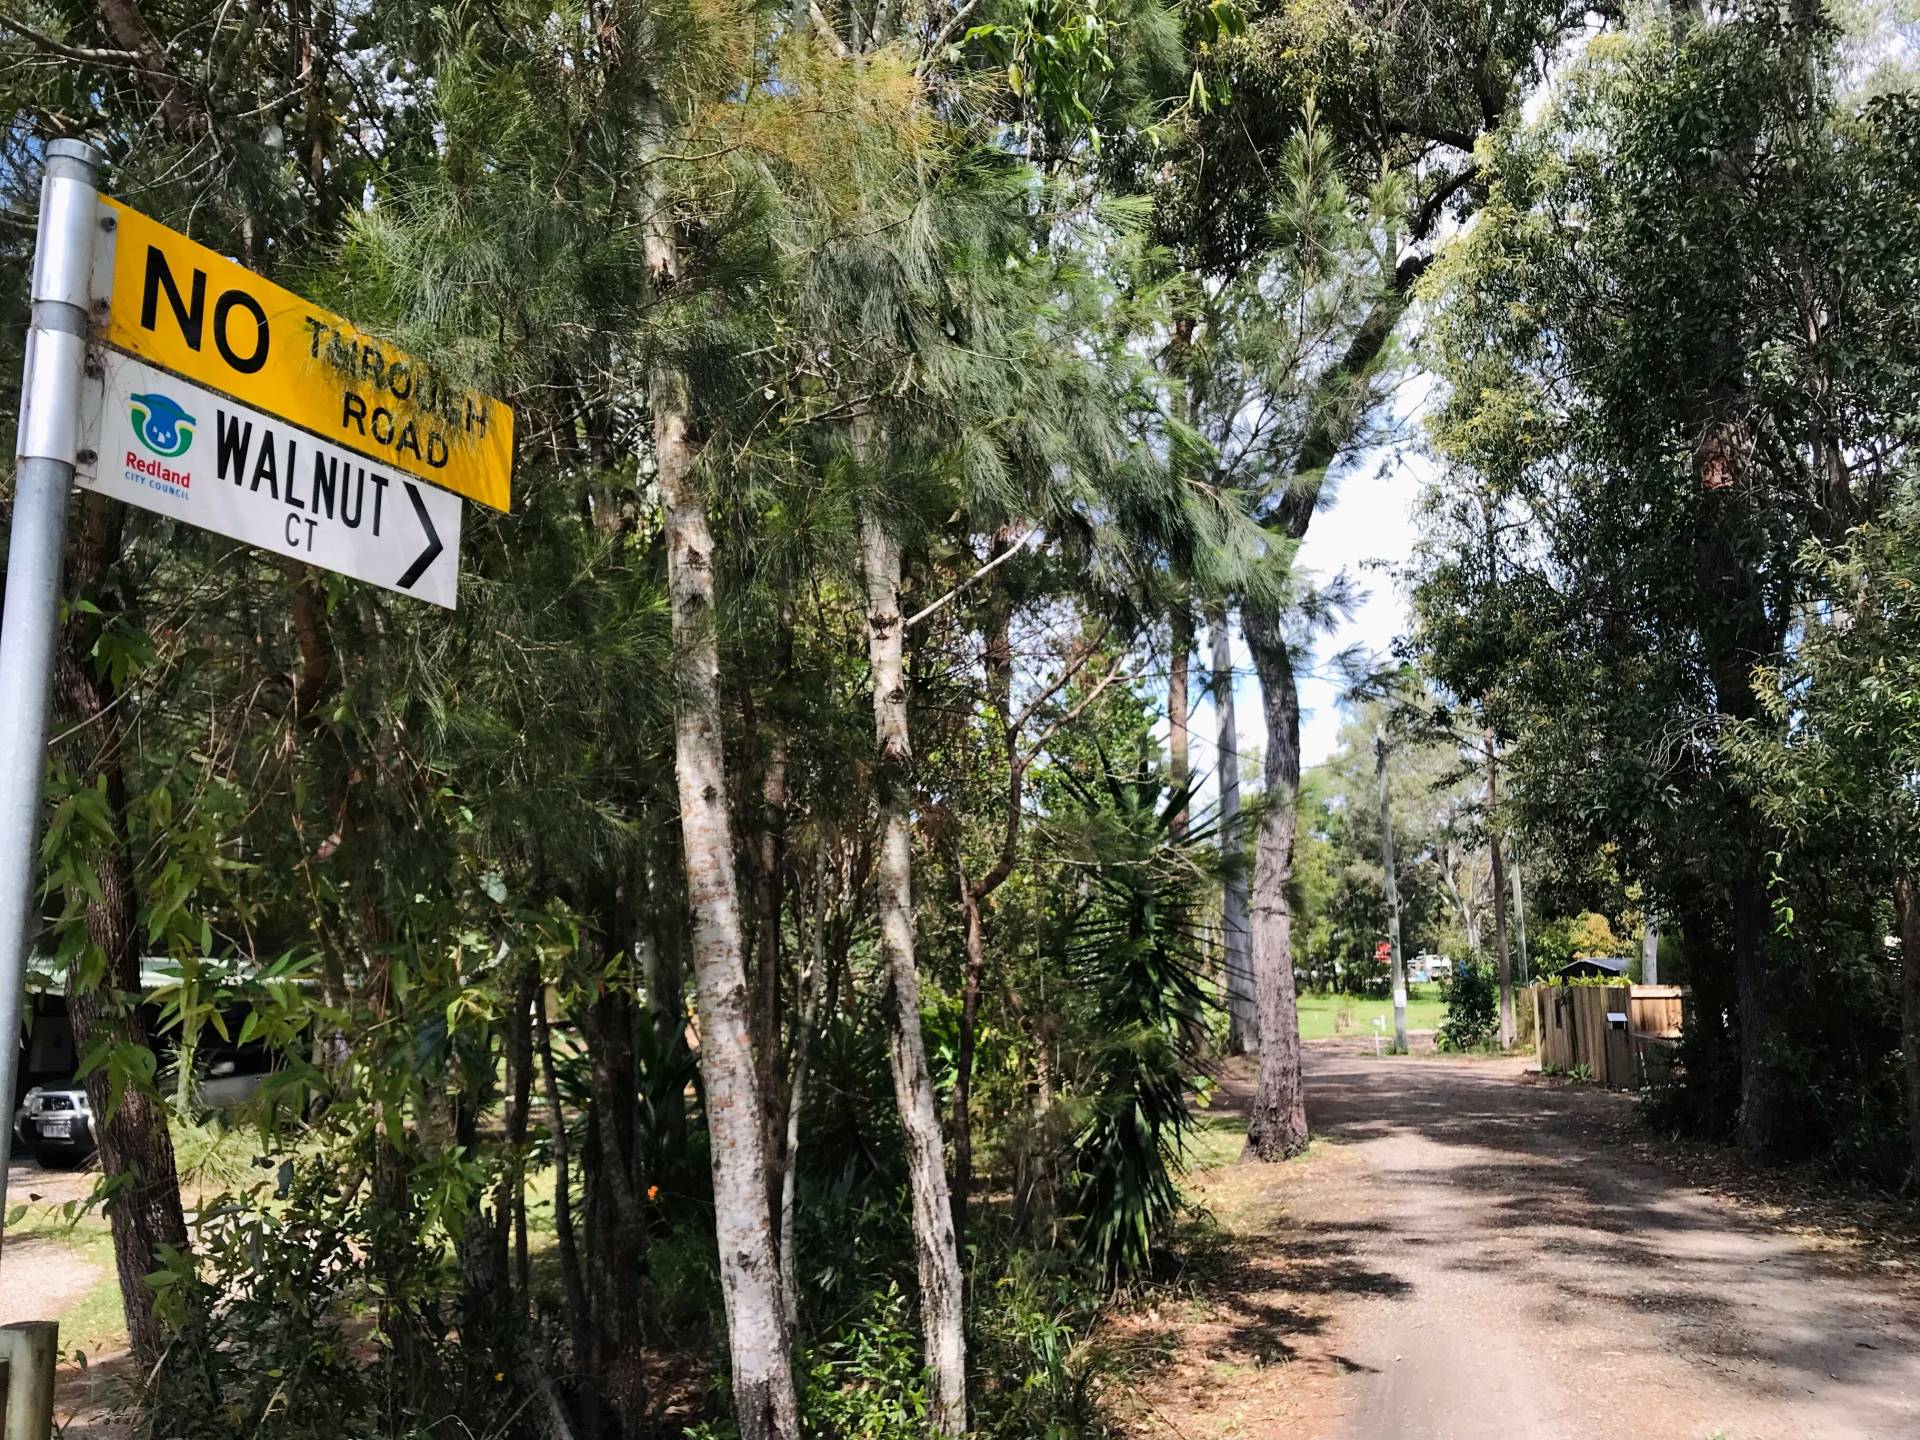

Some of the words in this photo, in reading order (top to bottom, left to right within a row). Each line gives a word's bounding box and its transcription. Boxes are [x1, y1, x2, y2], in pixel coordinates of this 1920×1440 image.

[140, 244, 270, 375] NO
[342, 391, 449, 469] ROAD
[124, 471, 146, 485] CITY
[148, 479, 190, 500] COUNCIL
[126, 451, 191, 489] Redland
[216, 409, 389, 537] WALNUT
[284, 515, 319, 552] CT
